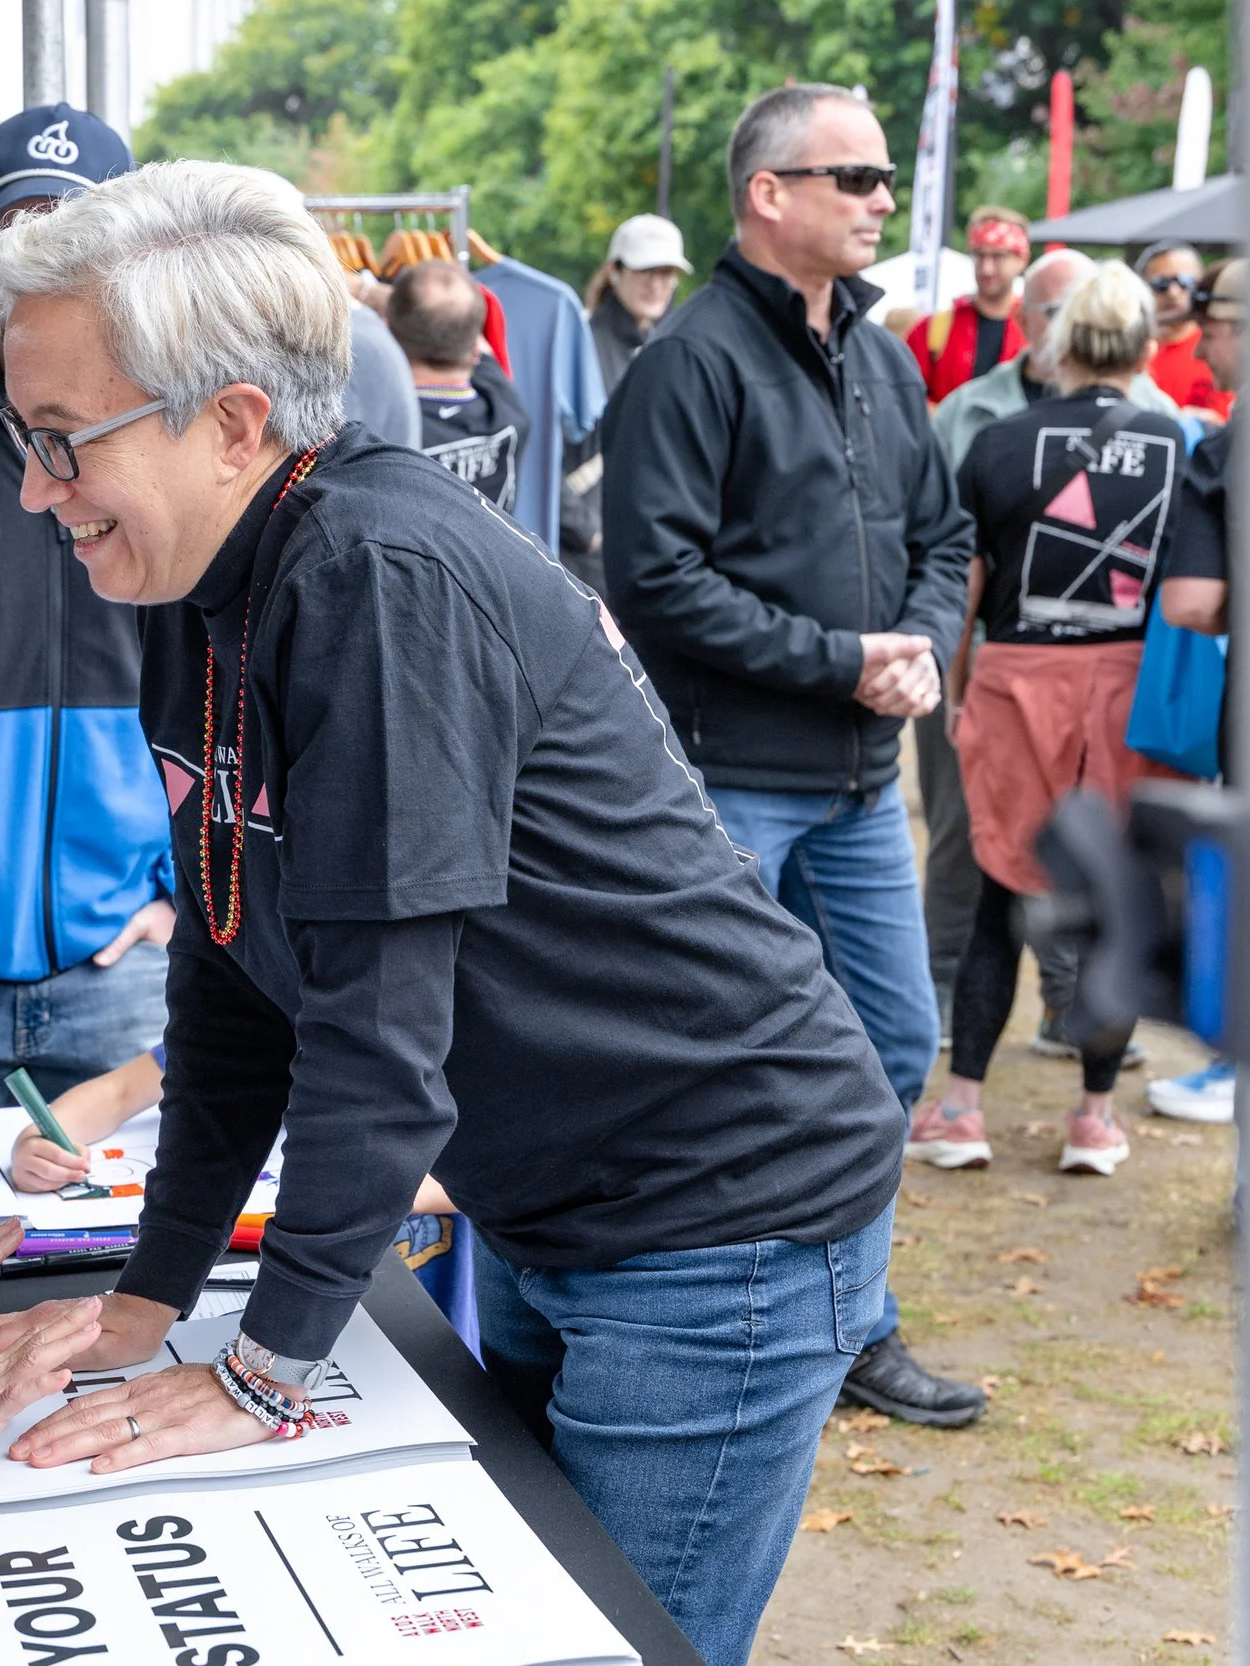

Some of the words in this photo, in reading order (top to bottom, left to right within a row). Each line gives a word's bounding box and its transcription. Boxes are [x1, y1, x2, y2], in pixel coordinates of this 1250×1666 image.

[249, 1402, 272, 1422] ALL
[326, 1515, 355, 1531] OF
[338, 1533, 384, 1578] WALKS
[360, 1503, 494, 1602] LIFE
[116, 1515, 260, 1666] STATUS
[370, 1579, 407, 1604] ALL
[390, 1615, 420, 1637] AIDS
[412, 1612, 442, 1635] WALK
[453, 1608, 484, 1629] WEST
